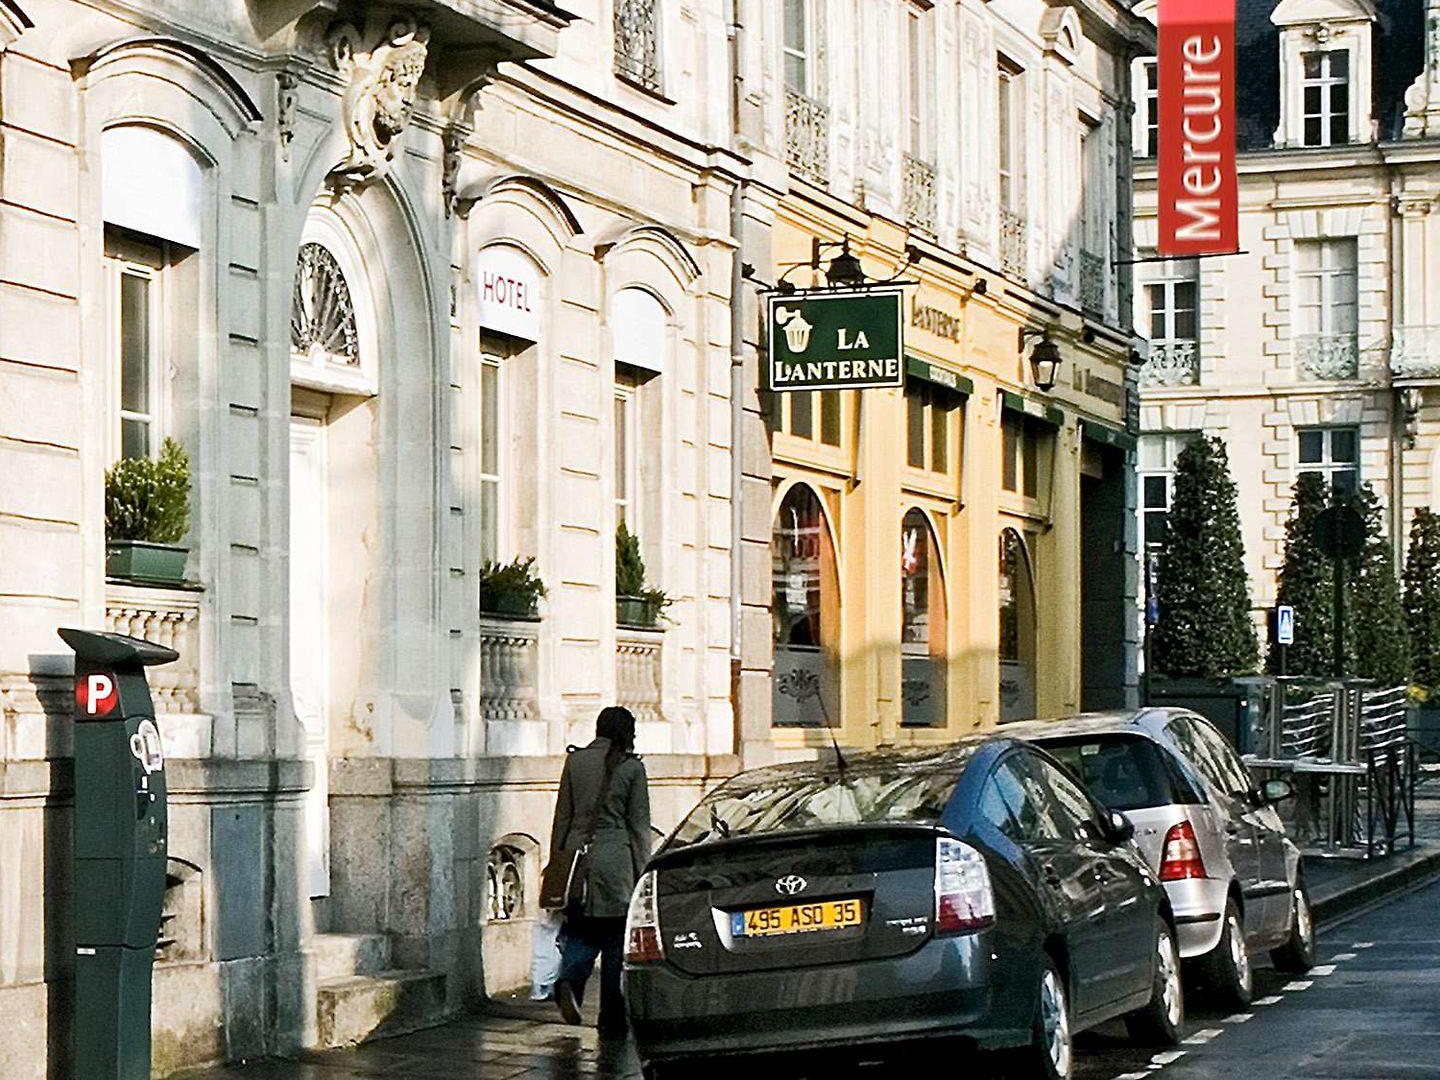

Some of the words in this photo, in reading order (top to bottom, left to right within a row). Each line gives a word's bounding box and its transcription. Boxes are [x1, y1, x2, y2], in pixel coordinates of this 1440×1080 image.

[1174, 34, 1222, 242] Mercure
[483, 271, 531, 313] HOTEL
[837, 328, 870, 350] LA
[774, 358, 898, 382] LANTERNE
[87, 674, 113, 714] P
[747, 910, 781, 931] 495
[833, 902, 856, 923] 35
